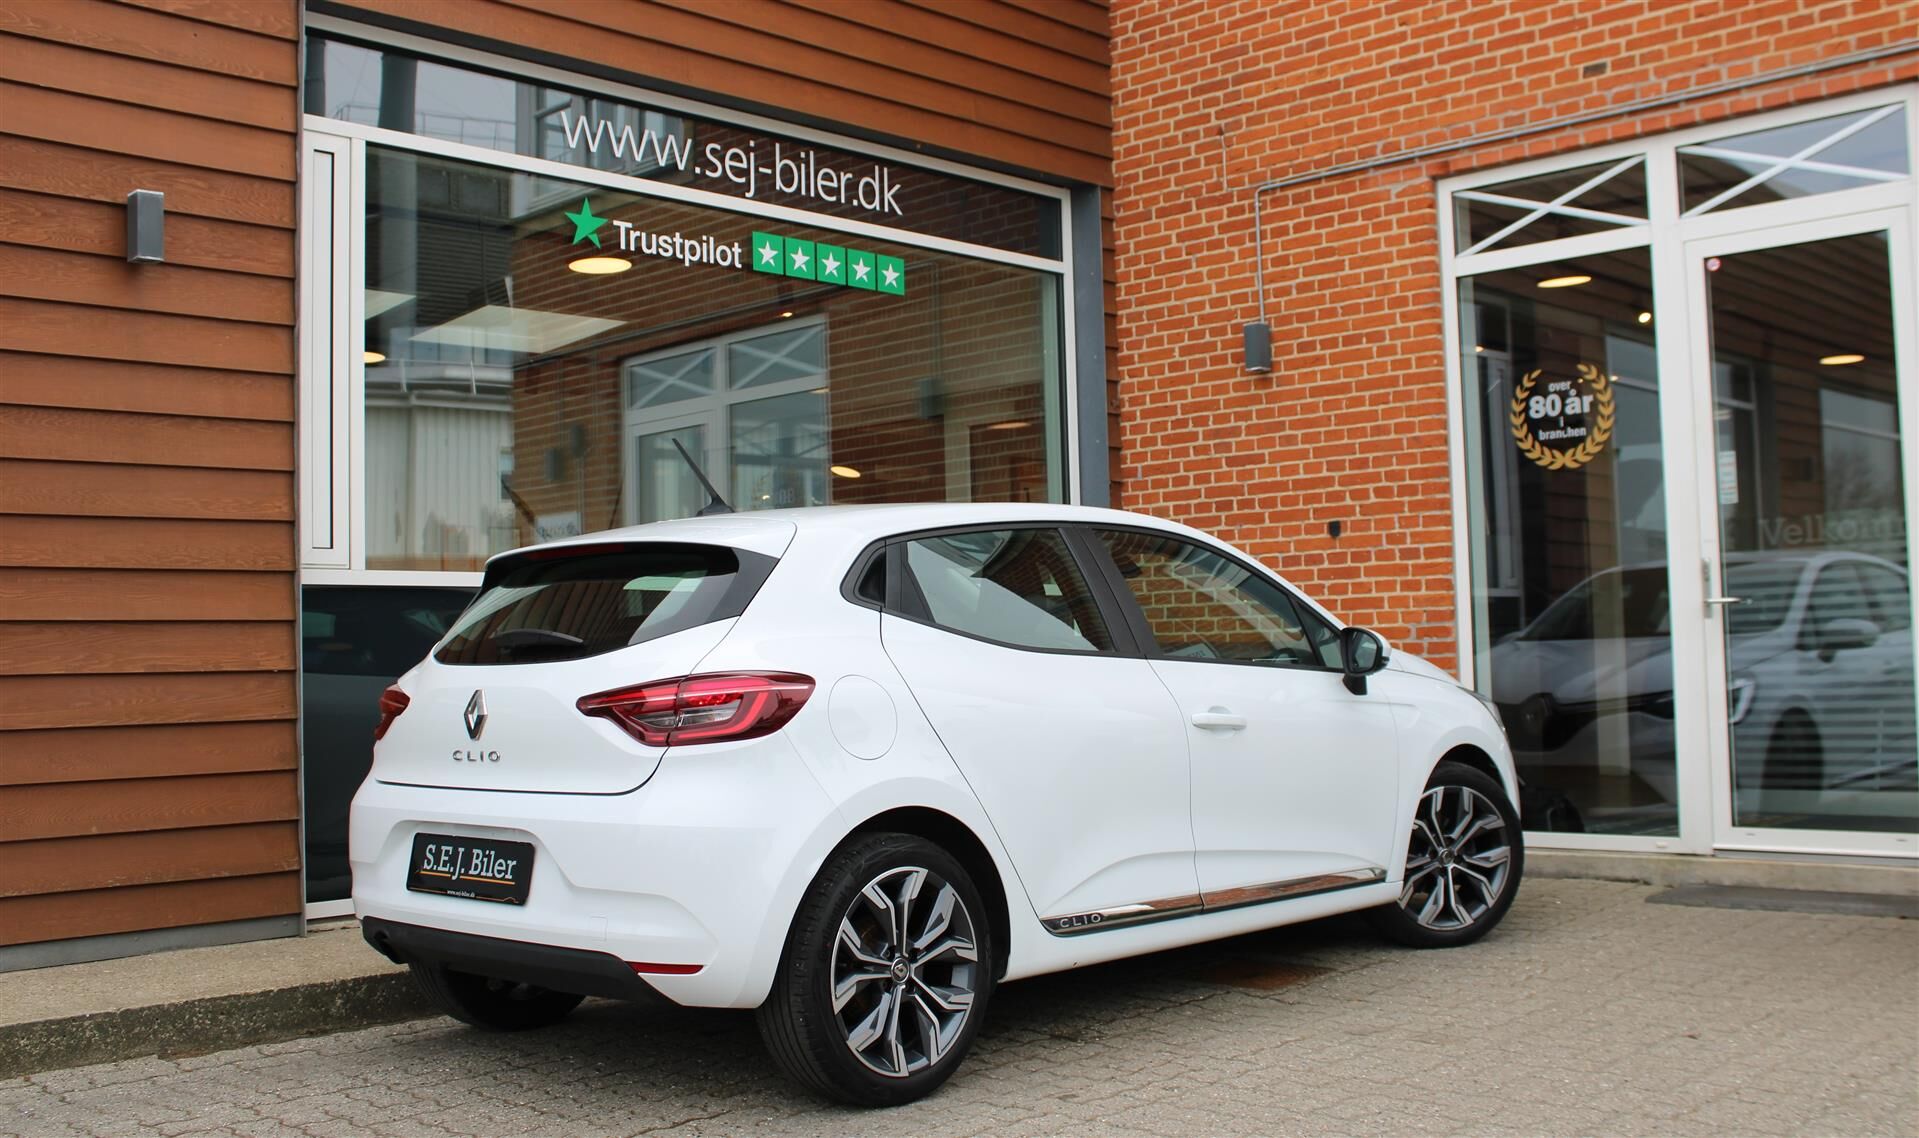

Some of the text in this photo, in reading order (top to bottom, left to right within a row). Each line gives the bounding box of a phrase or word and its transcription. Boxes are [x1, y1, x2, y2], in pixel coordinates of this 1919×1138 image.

[560, 111, 903, 216] www.sej-biler.dk
[612, 220, 742, 269] Trustpilot
[1548, 381, 1572, 392] over
[1529, 388, 1594, 418] 80 år
[452, 750, 501, 763] CLIO
[423, 844, 517, 880] S.E.J. Biler
[1059, 913, 1101, 928] CLIO
